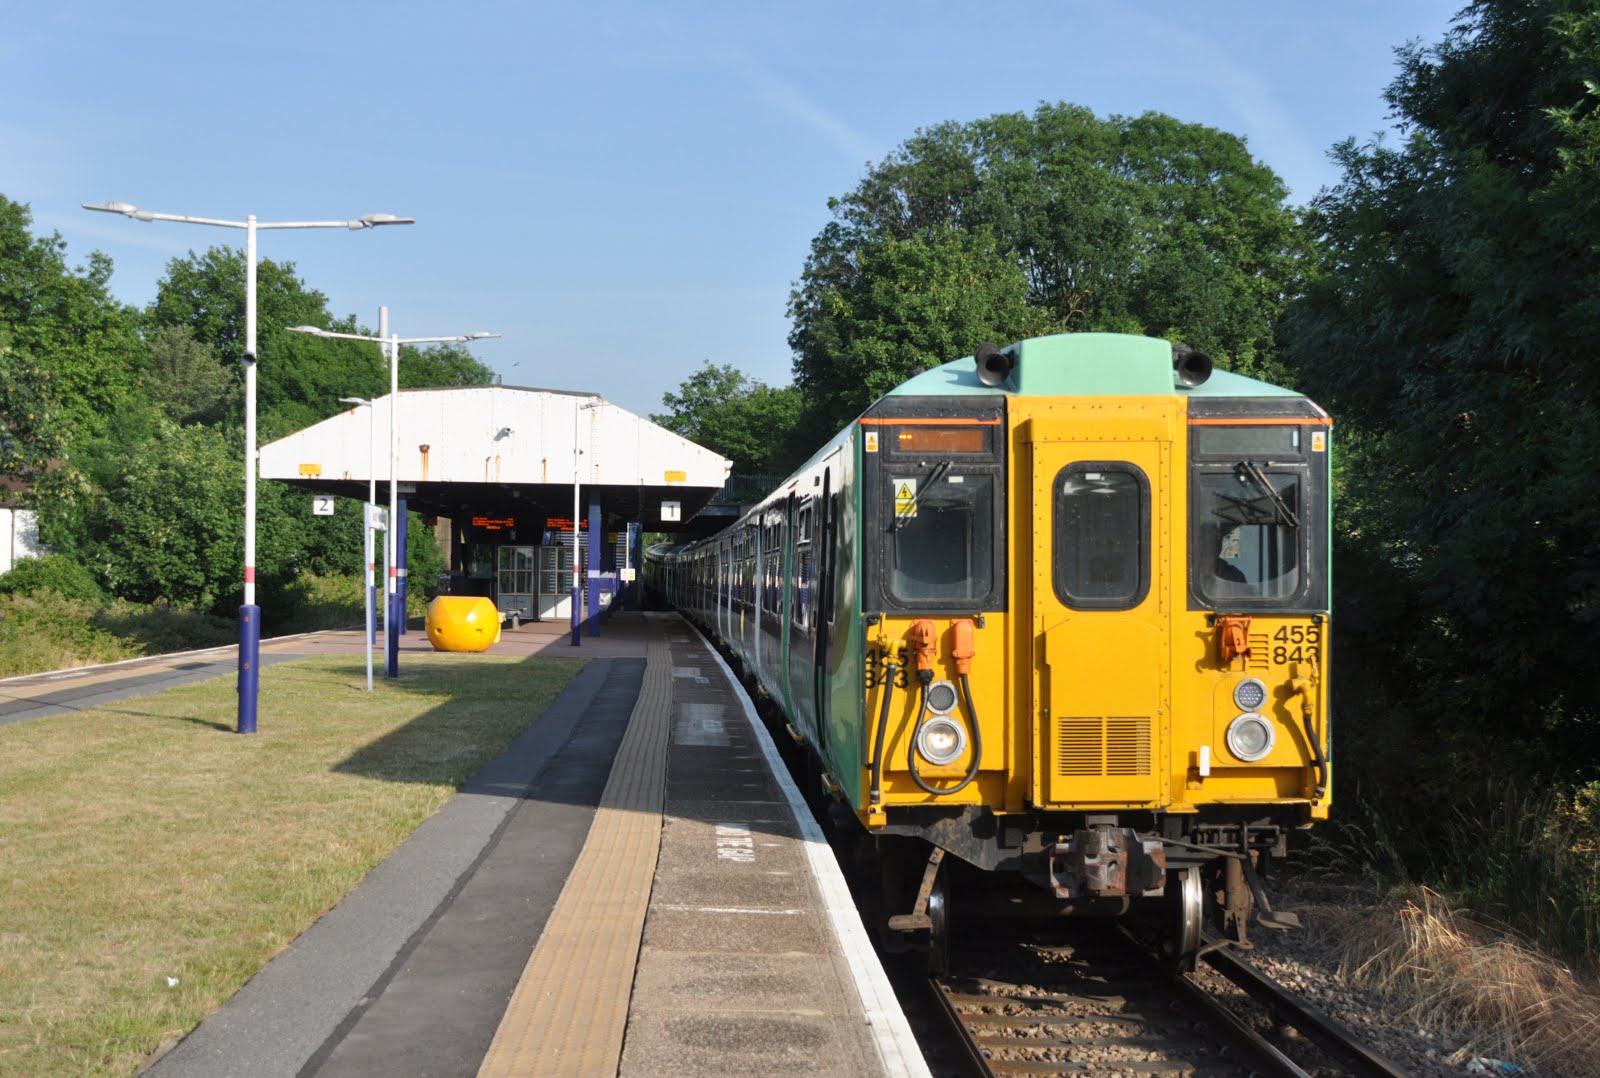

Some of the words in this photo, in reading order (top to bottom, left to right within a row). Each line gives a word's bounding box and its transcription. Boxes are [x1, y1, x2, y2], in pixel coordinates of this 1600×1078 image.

[319, 498, 328, 511] 2
[668, 504, 675, 517] 1
[1273, 625, 1320, 645] 455
[1273, 645, 1320, 665] 843
